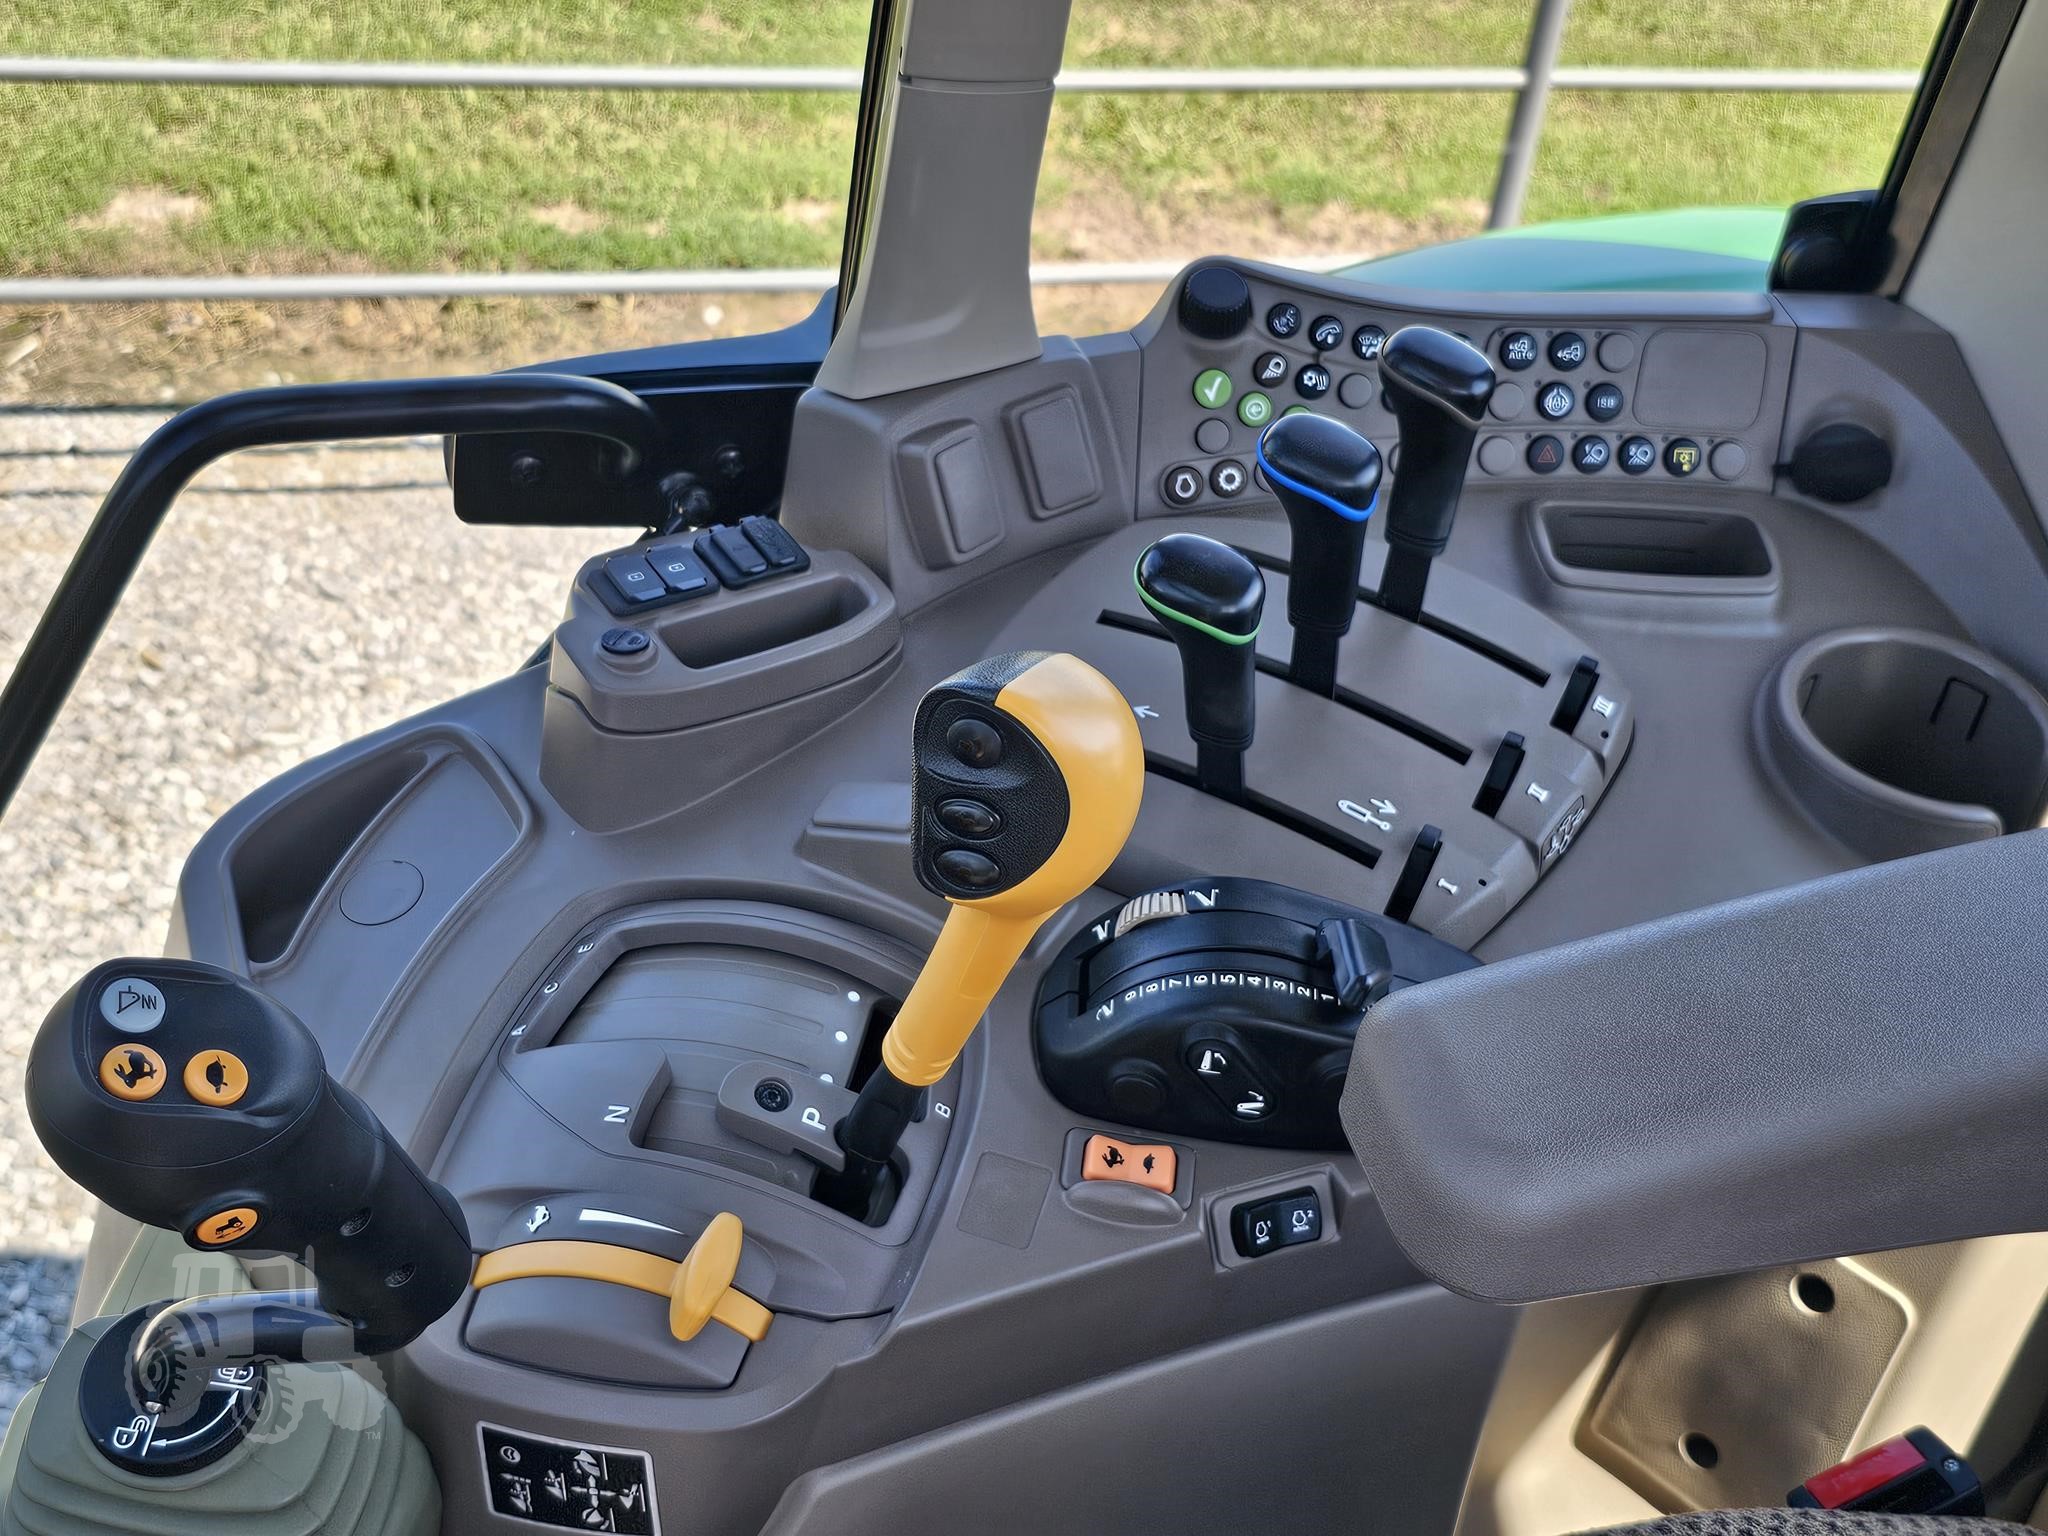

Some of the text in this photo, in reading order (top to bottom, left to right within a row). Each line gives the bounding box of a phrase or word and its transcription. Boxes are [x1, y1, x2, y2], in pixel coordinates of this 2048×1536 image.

[1508, 350, 1533, 360] AUTO
[1592, 695, 1615, 717] III
[1526, 782, 1549, 803] II
[1437, 878, 1458, 895] I
[578, 943, 593, 953] E
[544, 982, 558, 993] C
[1124, 974, 1334, 1001] 9 8 7 6 5 4 3 2 1
[511, 1025, 526, 1035] A
[603, 1105, 630, 1123] N
[801, 1107, 827, 1131] P
[934, 1102, 951, 1119] B
